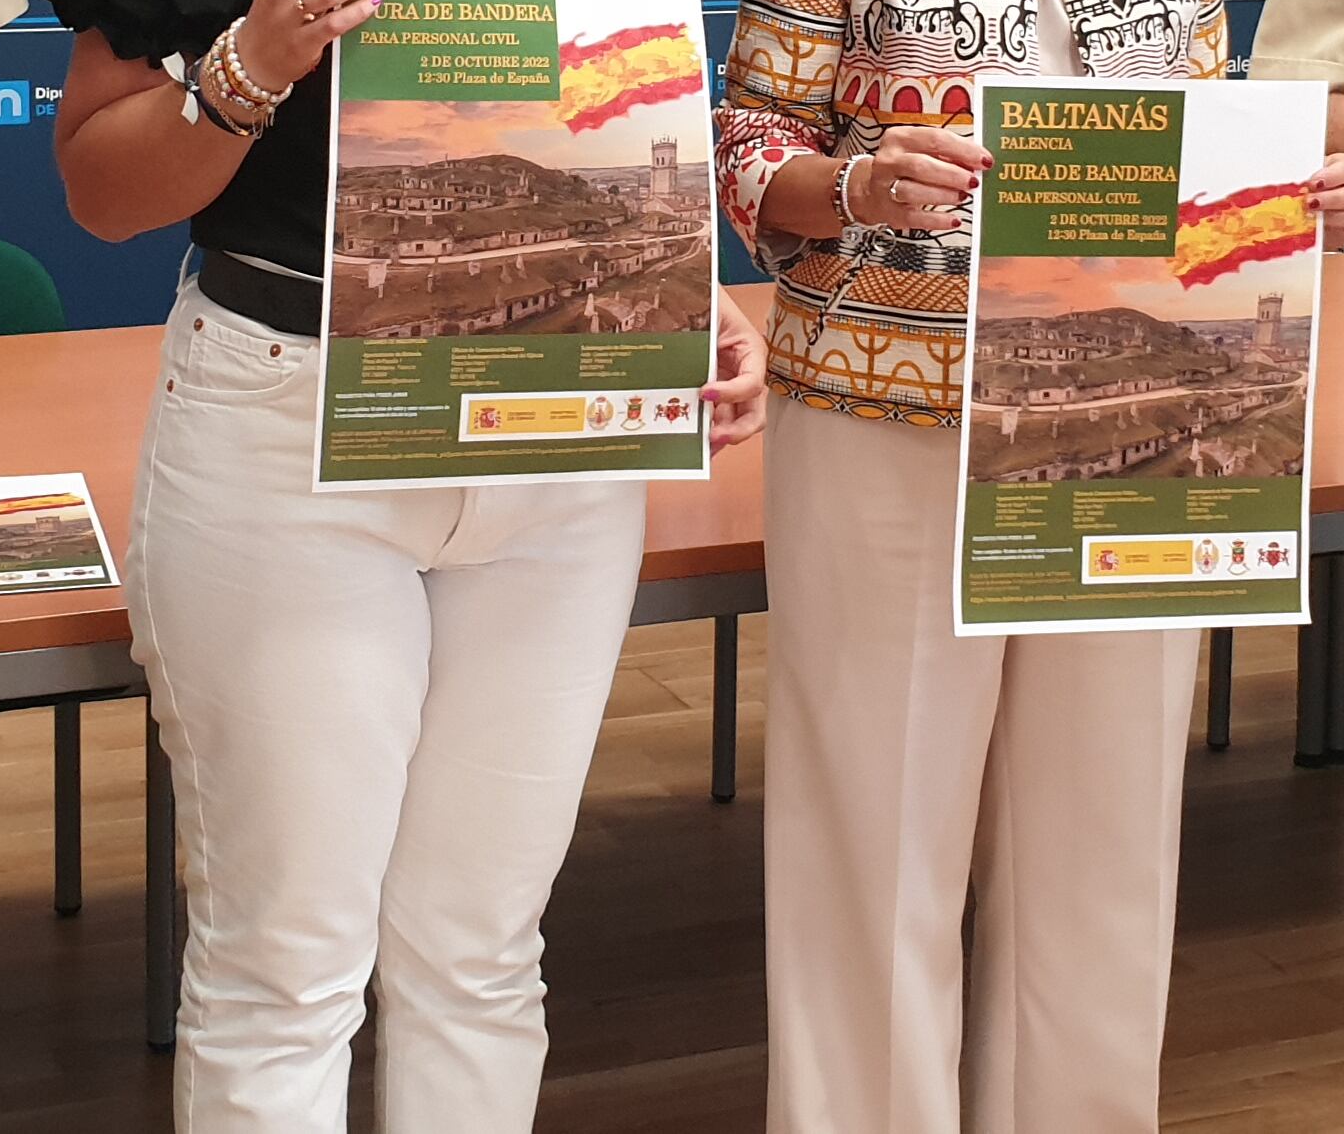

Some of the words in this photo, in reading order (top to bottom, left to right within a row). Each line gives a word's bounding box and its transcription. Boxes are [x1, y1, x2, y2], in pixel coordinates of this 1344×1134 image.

[374, 2, 419, 20] URA
[423, 3, 454, 20] DE
[458, 3, 554, 22] BANDERA
[359, 31, 399, 44] PARA
[401, 32, 479, 45] PERSONAL
[481, 33, 519, 45] CIVIL
[420, 56, 428, 68] 2
[431, 55, 452, 68] DE
[454, 55, 520, 68] OCTUBRE
[522, 56, 550, 68] 2022
[417, 72, 450, 84] 12:30
[453, 72, 487, 84] Plaza
[490, 73, 505, 84] de
[507, 72, 551, 86] España
[1000, 96, 1168, 131] BALTANÁS
[1000, 136, 1074, 150] PALENCIA
[998, 163, 1050, 180] JURA
[1053, 164, 1081, 180] DE
[1085, 164, 1177, 182] BANDERA
[997, 191, 1032, 204] PARA
[1034, 191, 1103, 204] PERSONAL
[1105, 192, 1142, 205] CIVIL
[1050, 214, 1057, 225] 2
[1059, 214, 1078, 225] DE
[1079, 214, 1140, 226] OCTUBRE
[1078, 229, 1109, 240] Plaza
[1111, 230, 1124, 240] de
[1126, 229, 1167, 242] España
